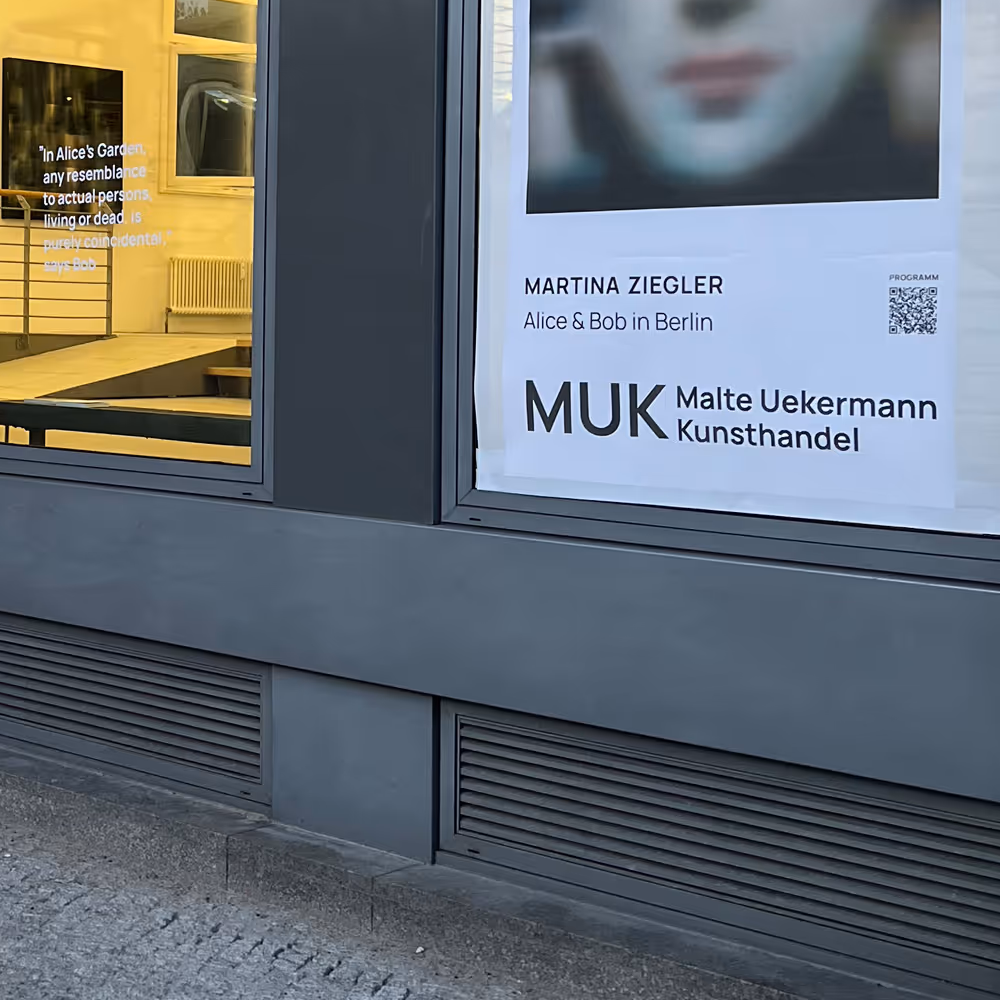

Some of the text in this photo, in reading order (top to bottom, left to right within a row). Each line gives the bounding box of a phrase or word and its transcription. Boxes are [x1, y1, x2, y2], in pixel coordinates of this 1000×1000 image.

[56, 144, 95, 161] Alice's
[43, 164, 147, 187] any resemblance
[43, 188, 153, 207] to actual persons,
[43, 213, 76, 231] living
[78, 213, 92, 226] or
[131, 211, 142, 223] is
[43, 234, 82, 254] purely
[525, 275, 723, 295] MARTINA ZIEGLER
[523, 311, 713, 332] Alice & Bob in Berlin
[525, 379, 669, 440] MUK
[676, 385, 938, 420] Malte Uekermann
[677, 418, 860, 452] Kunsthandel
